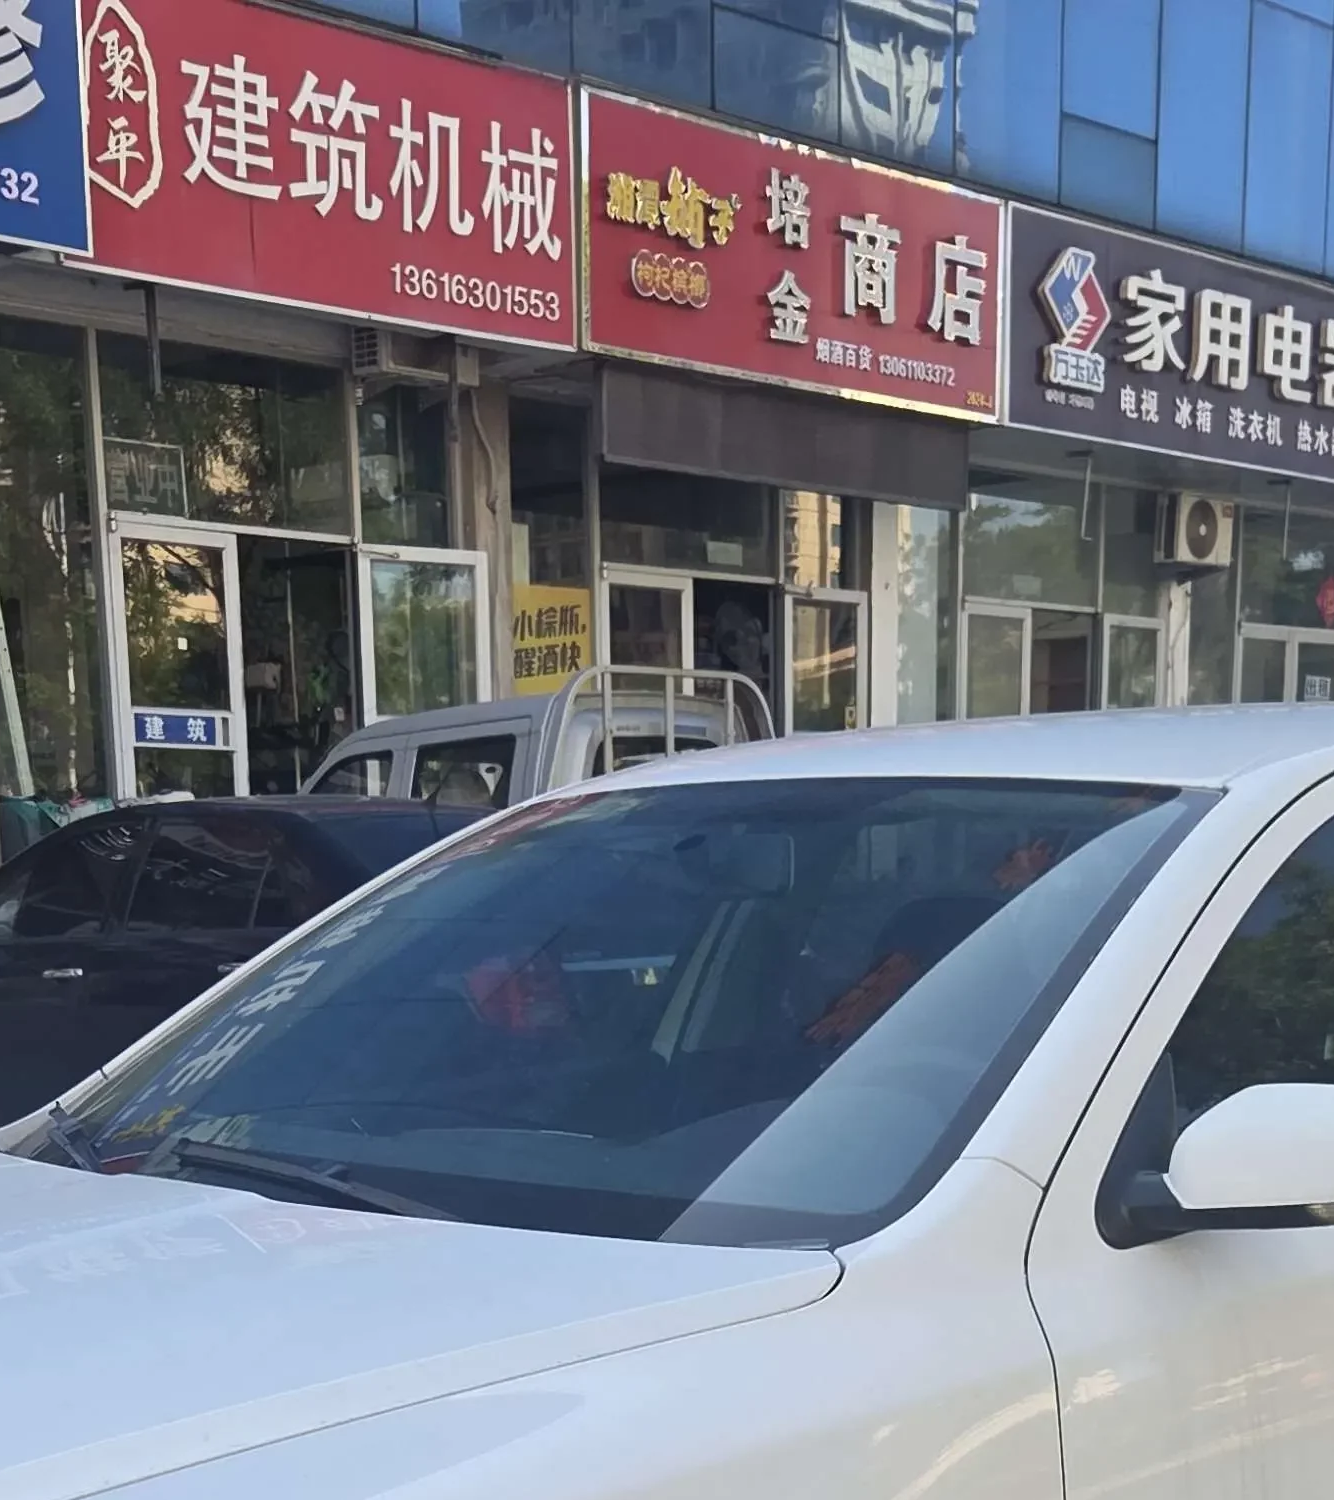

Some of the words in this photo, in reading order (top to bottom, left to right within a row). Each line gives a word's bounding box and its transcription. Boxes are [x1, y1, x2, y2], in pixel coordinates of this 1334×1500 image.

[180, 53, 562, 264] 建筑机械
[390, 262, 561, 323] 13616301553
[839, 213, 989, 346] 商店
[815, 337, 873, 372] 烟酒百货
[878, 354, 956, 388] 13061103372
[1120, 384, 1160, 424] 电视
[1174, 396, 1214, 434] 冰箱
[1228, 405, 1284, 447] 洗衣机
[143, 715, 208, 742] 建筑
